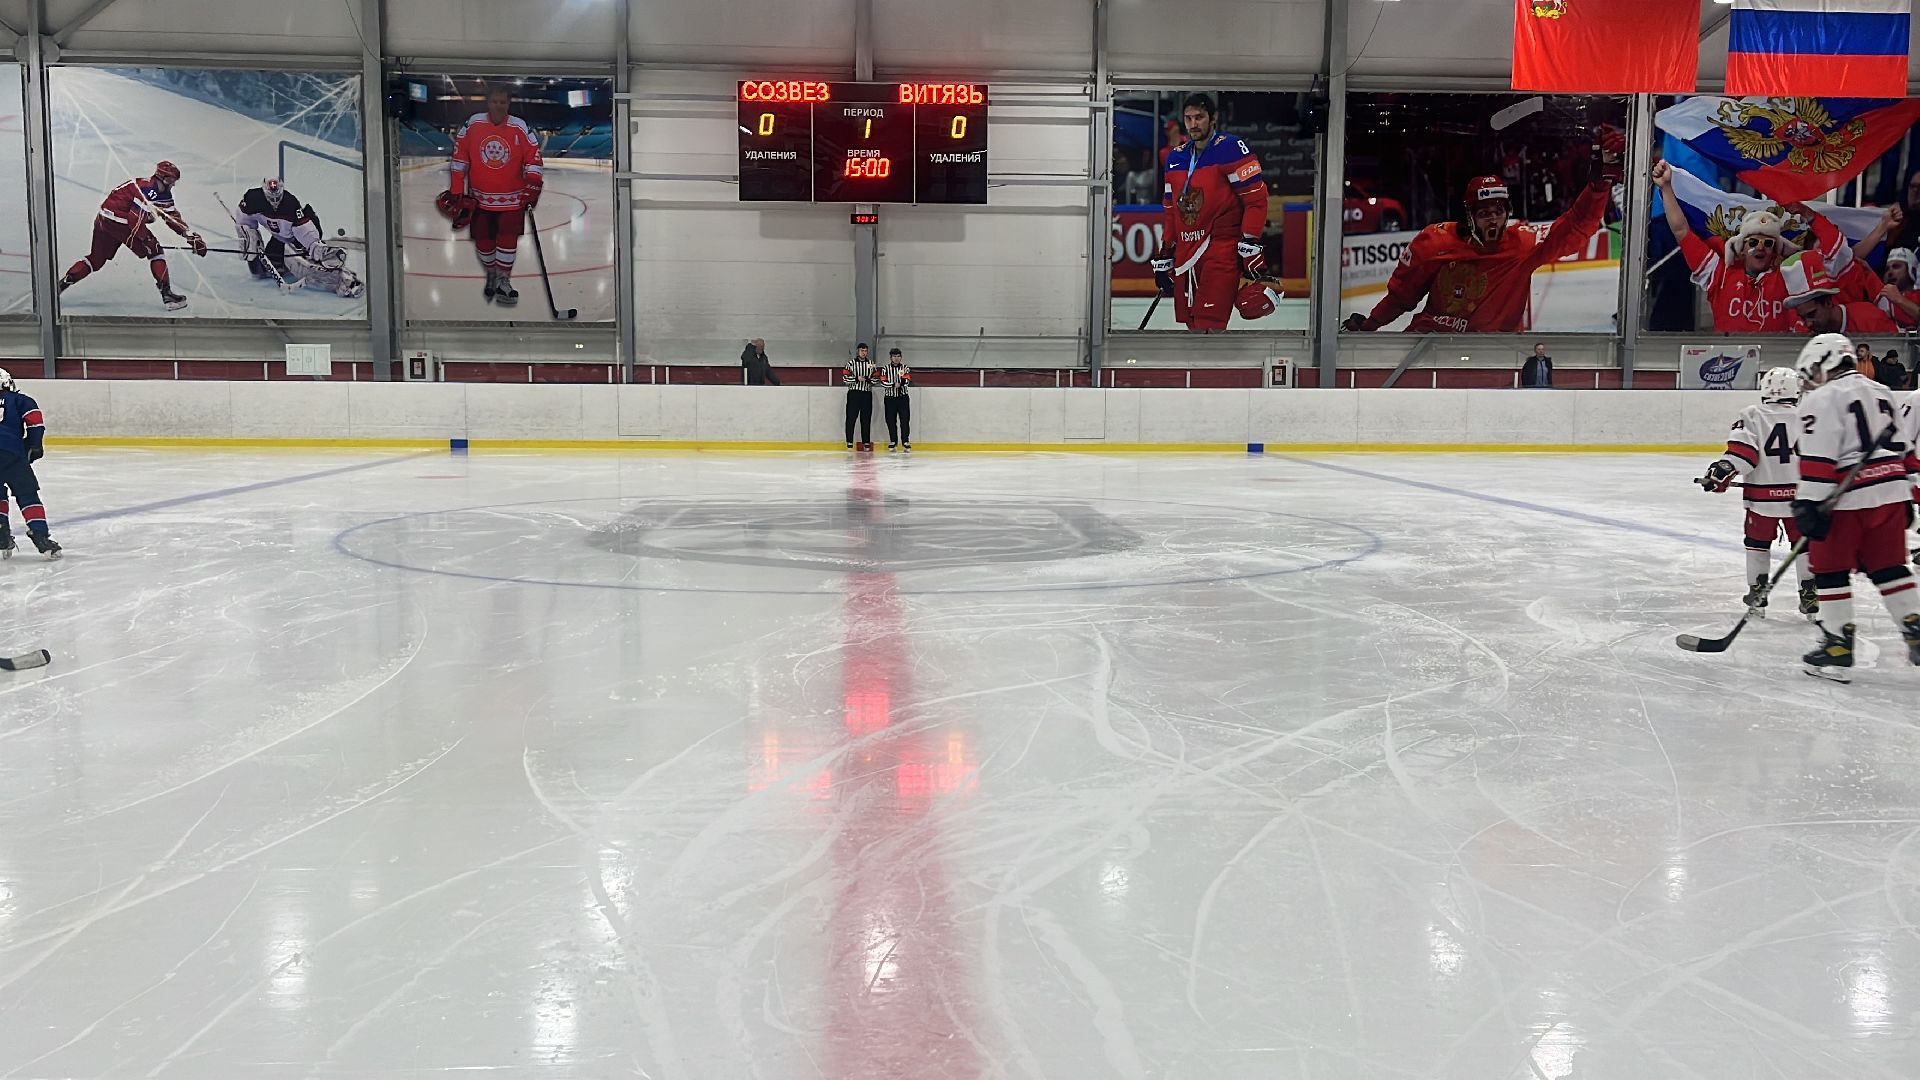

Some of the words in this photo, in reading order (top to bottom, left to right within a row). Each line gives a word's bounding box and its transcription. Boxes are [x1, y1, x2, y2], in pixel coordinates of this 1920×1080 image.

[742, 81, 830, 101] СОЗВЕЗ
[900, 83, 983, 104] ВИТЯЗЬ
[843, 108, 884, 118] ПЕРИОД
[758, 113, 775, 136] 0
[864, 118, 872, 139] 1
[951, 115, 967, 139] 0
[744, 150, 797, 160] УДАЛЕНИЯ
[847, 149, 881, 158] ВРЕМЯ
[1236, 139, 1250, 155] 8
[844, 157, 890, 177] 15:00
[929, 153, 981, 163] УДАЛЕНИЯ
[1728, 297, 1782, 319] СССР
[1848, 399, 1906, 453] 12
[1764, 422, 1793, 464] 4
